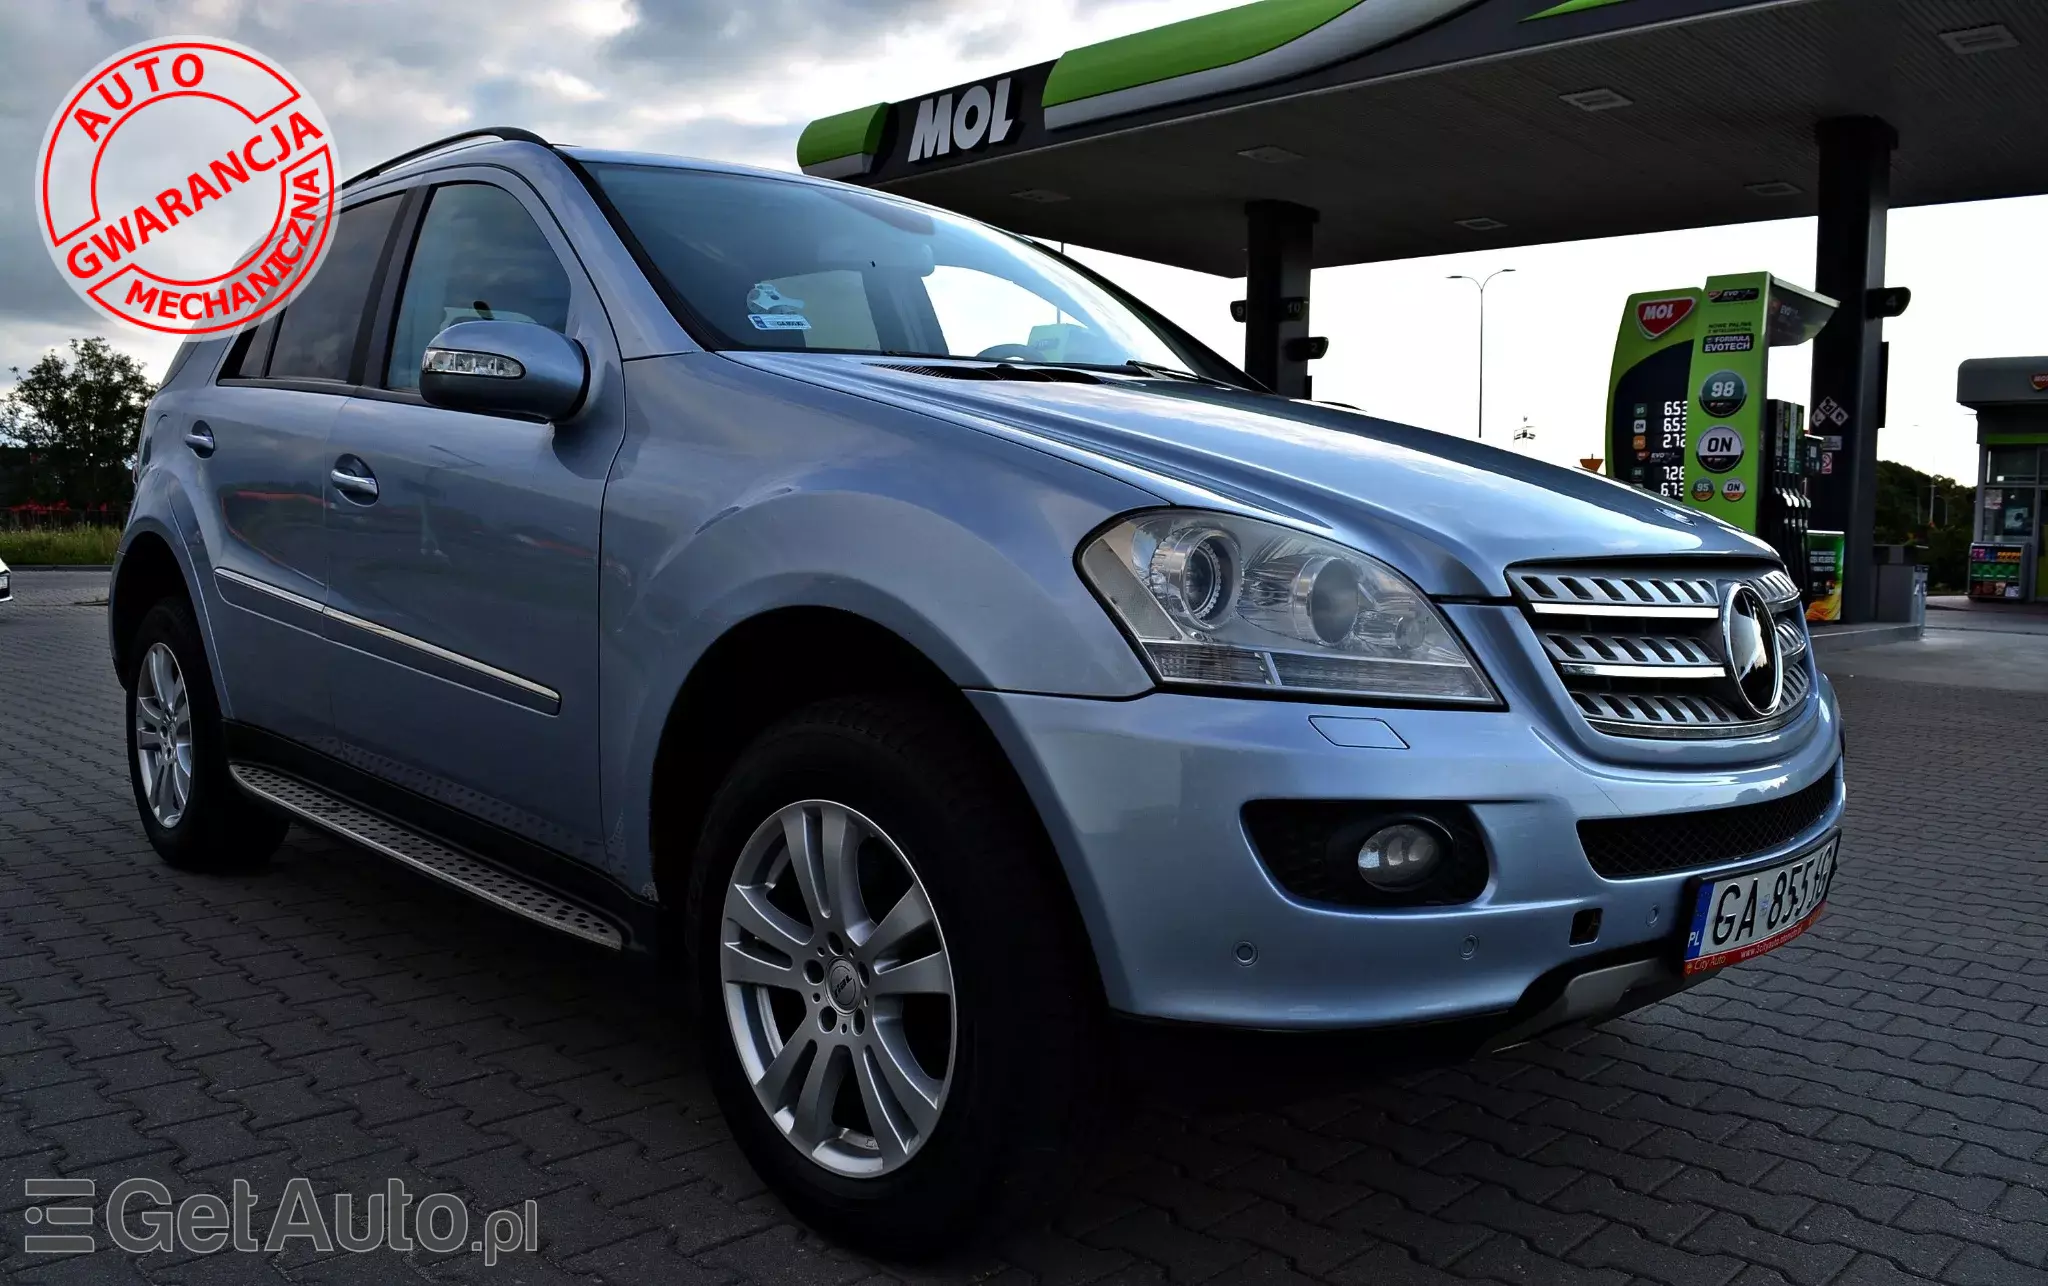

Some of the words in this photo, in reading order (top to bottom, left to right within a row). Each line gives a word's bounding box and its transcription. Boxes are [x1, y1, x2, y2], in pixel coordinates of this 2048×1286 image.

[908, 78, 1015, 162] MOL
[1236, 305, 1243, 316] 9
[1287, 301, 1301, 313] 10
[1643, 303, 1674, 321] MOL
[1704, 342, 1751, 352] EVOTECH
[1711, 381, 1735, 398] 98
[1707, 437, 1733, 452] ON
[1696, 483, 1709, 492] 95
[1727, 483, 1740, 491] ON
[1713, 877, 1759, 946] GA
[1687, 931, 1700, 948] PL
